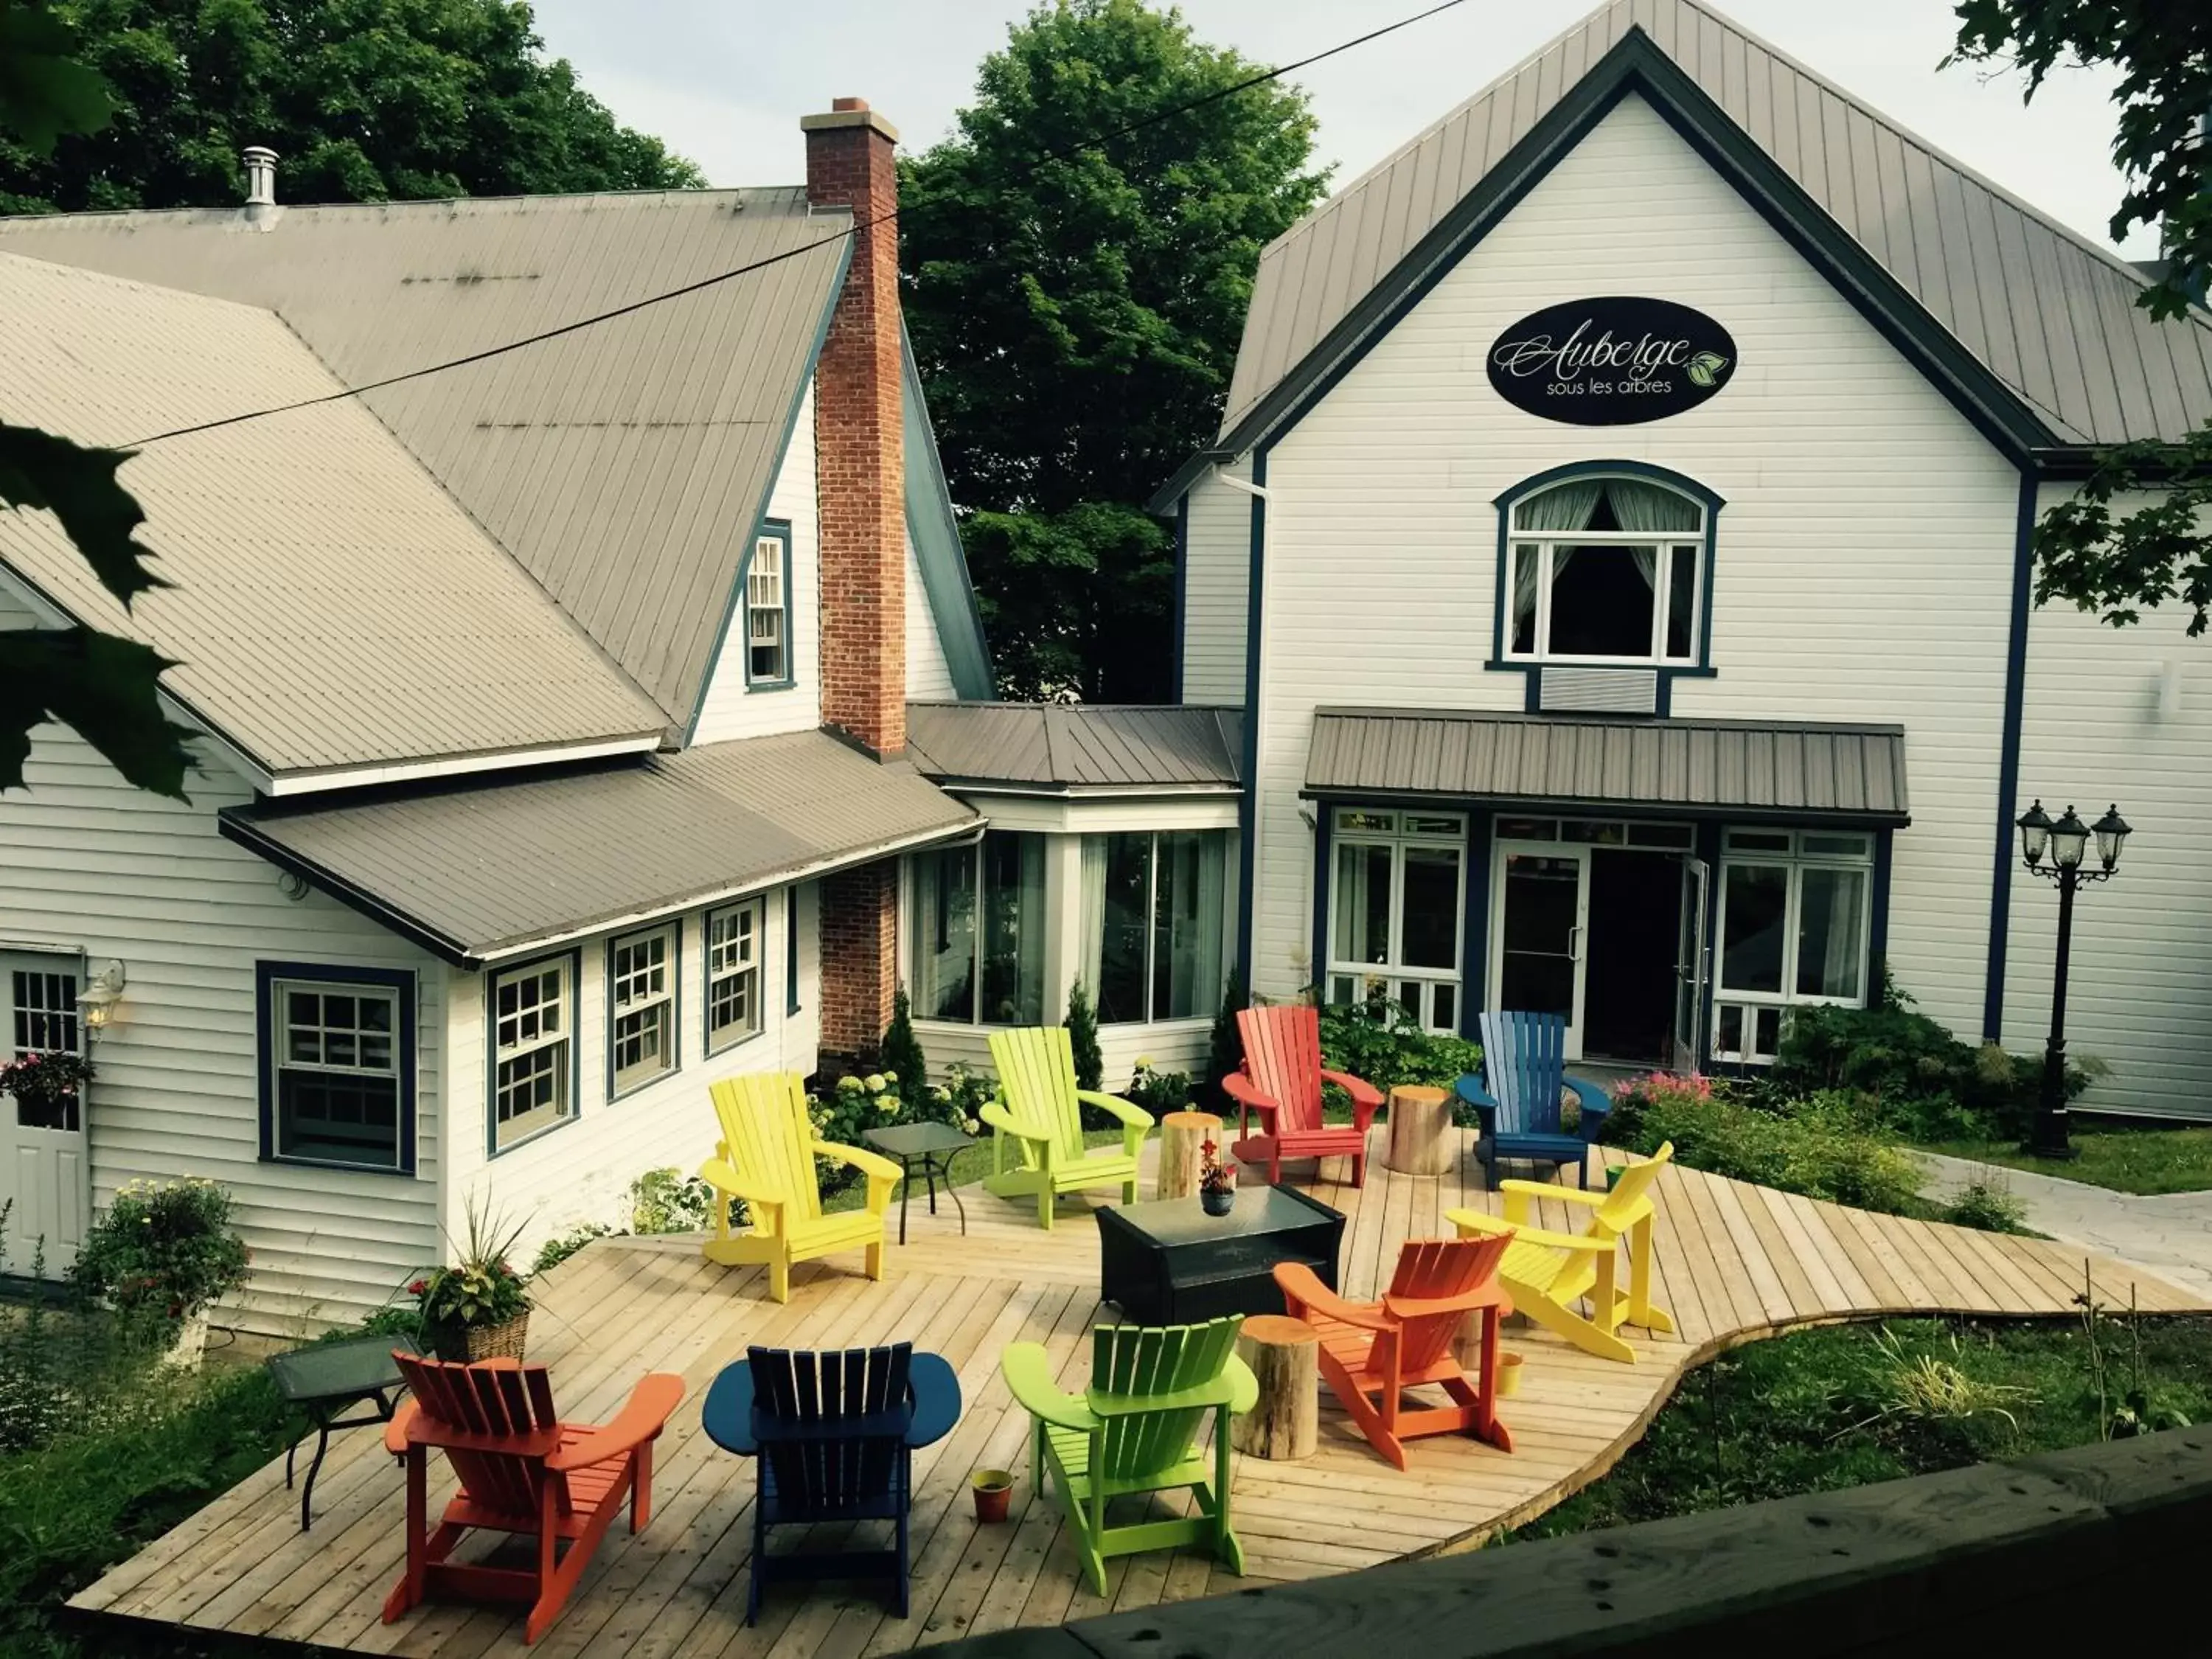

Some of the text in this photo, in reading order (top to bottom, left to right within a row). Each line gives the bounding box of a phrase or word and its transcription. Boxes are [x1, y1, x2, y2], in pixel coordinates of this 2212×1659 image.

[1494, 319, 1689, 380] Auberge
[1547, 378, 1672, 396] sous les arbres
